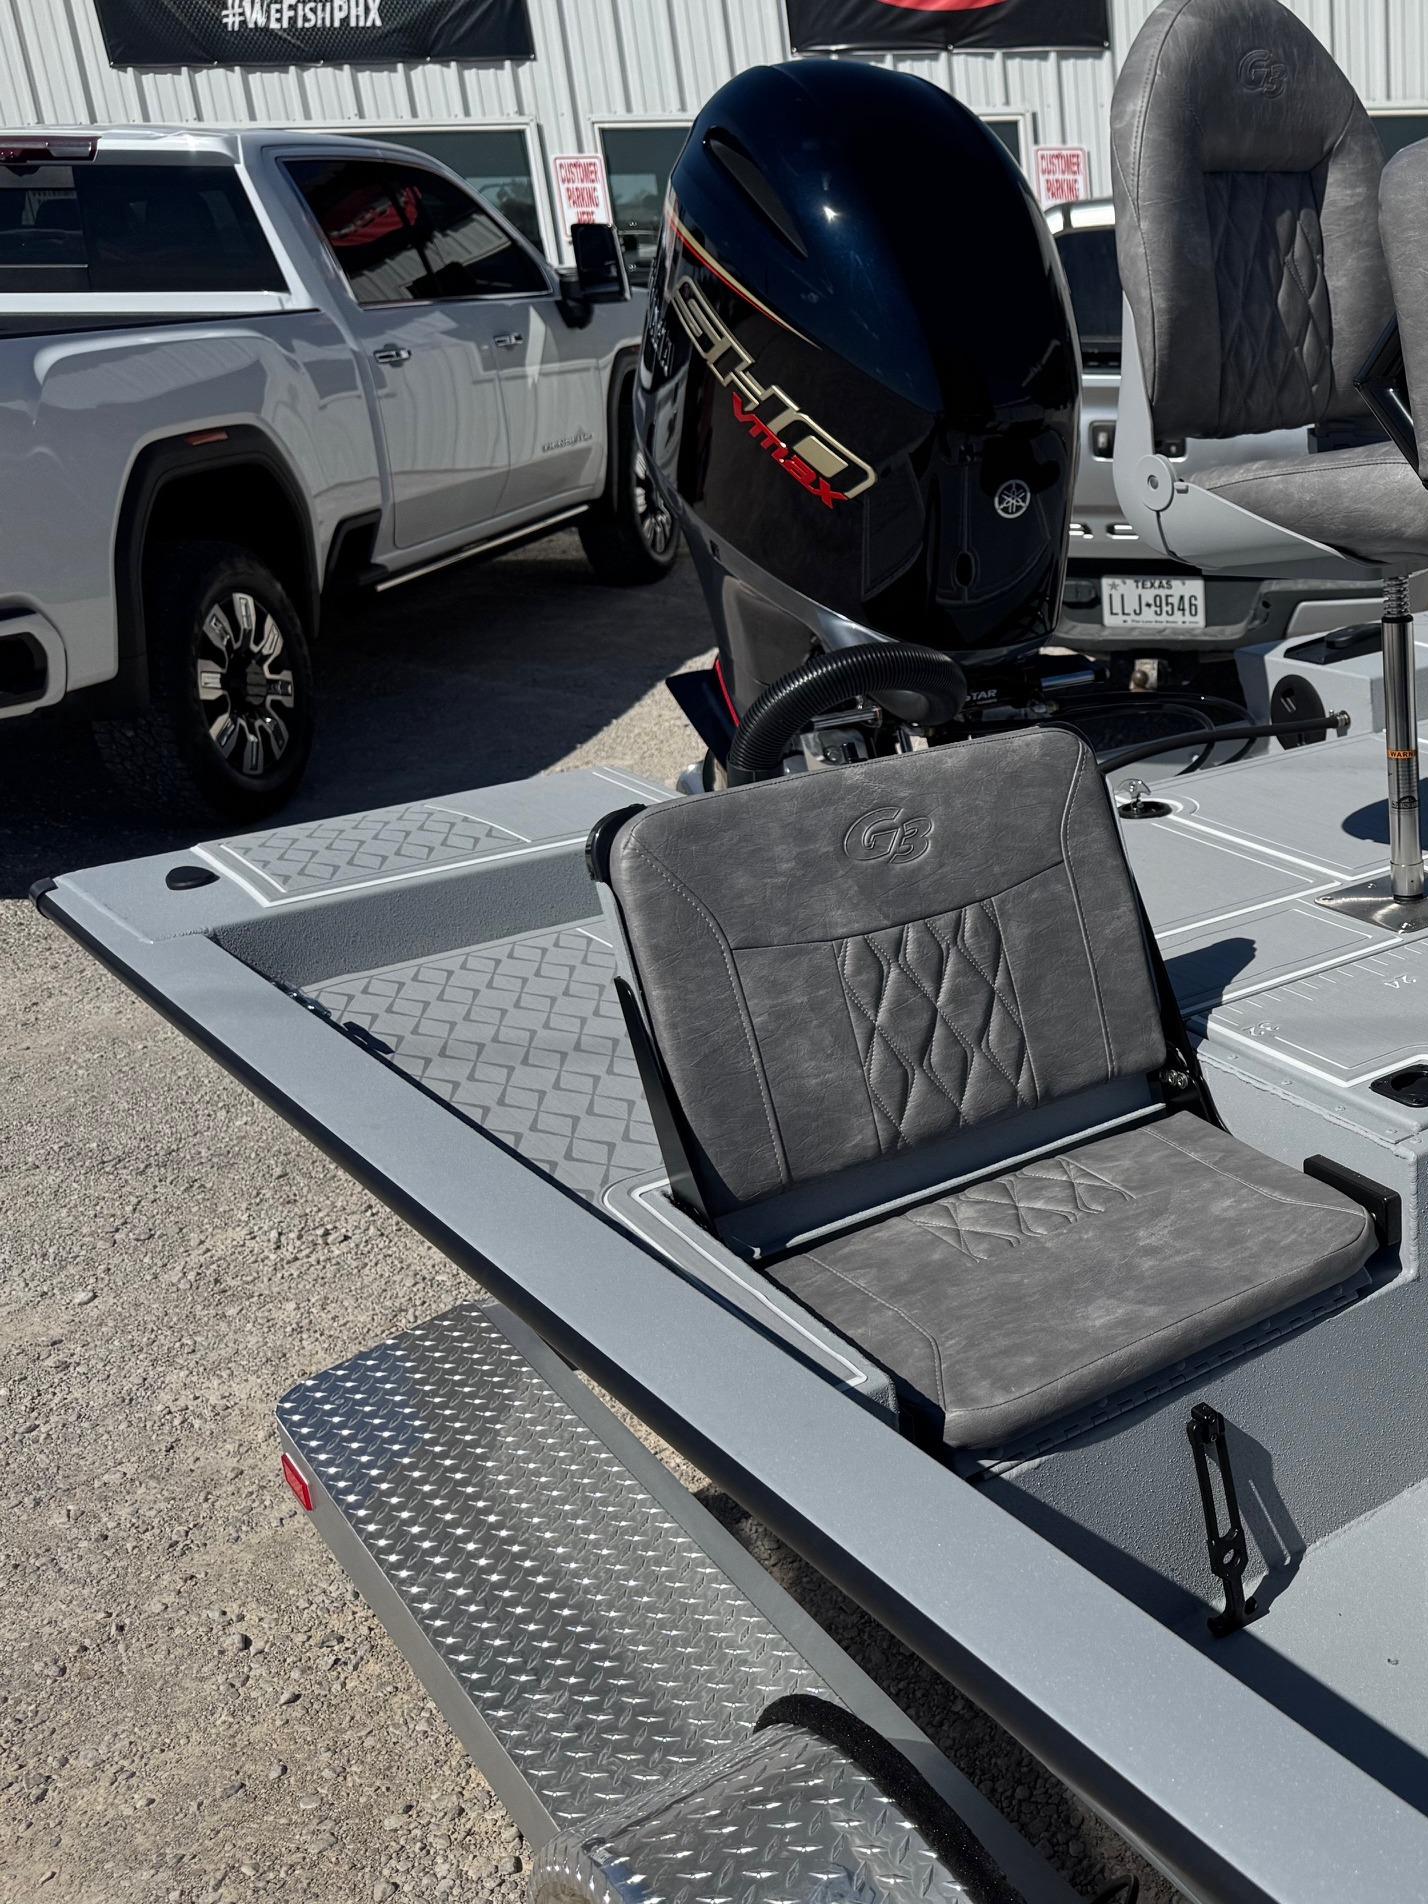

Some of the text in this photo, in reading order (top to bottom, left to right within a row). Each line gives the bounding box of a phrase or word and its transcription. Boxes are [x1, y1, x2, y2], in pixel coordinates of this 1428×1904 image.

[1237, 48, 1288, 100] G3
[559, 160, 600, 184] CUSTOMER
[1040, 152, 1080, 176] CUSTOMER
[565, 186, 600, 208] PARKING
[1045, 178, 1080, 201] PARKING
[1133, 579, 1173, 591] TEXAS
[842, 806, 934, 864] G3
